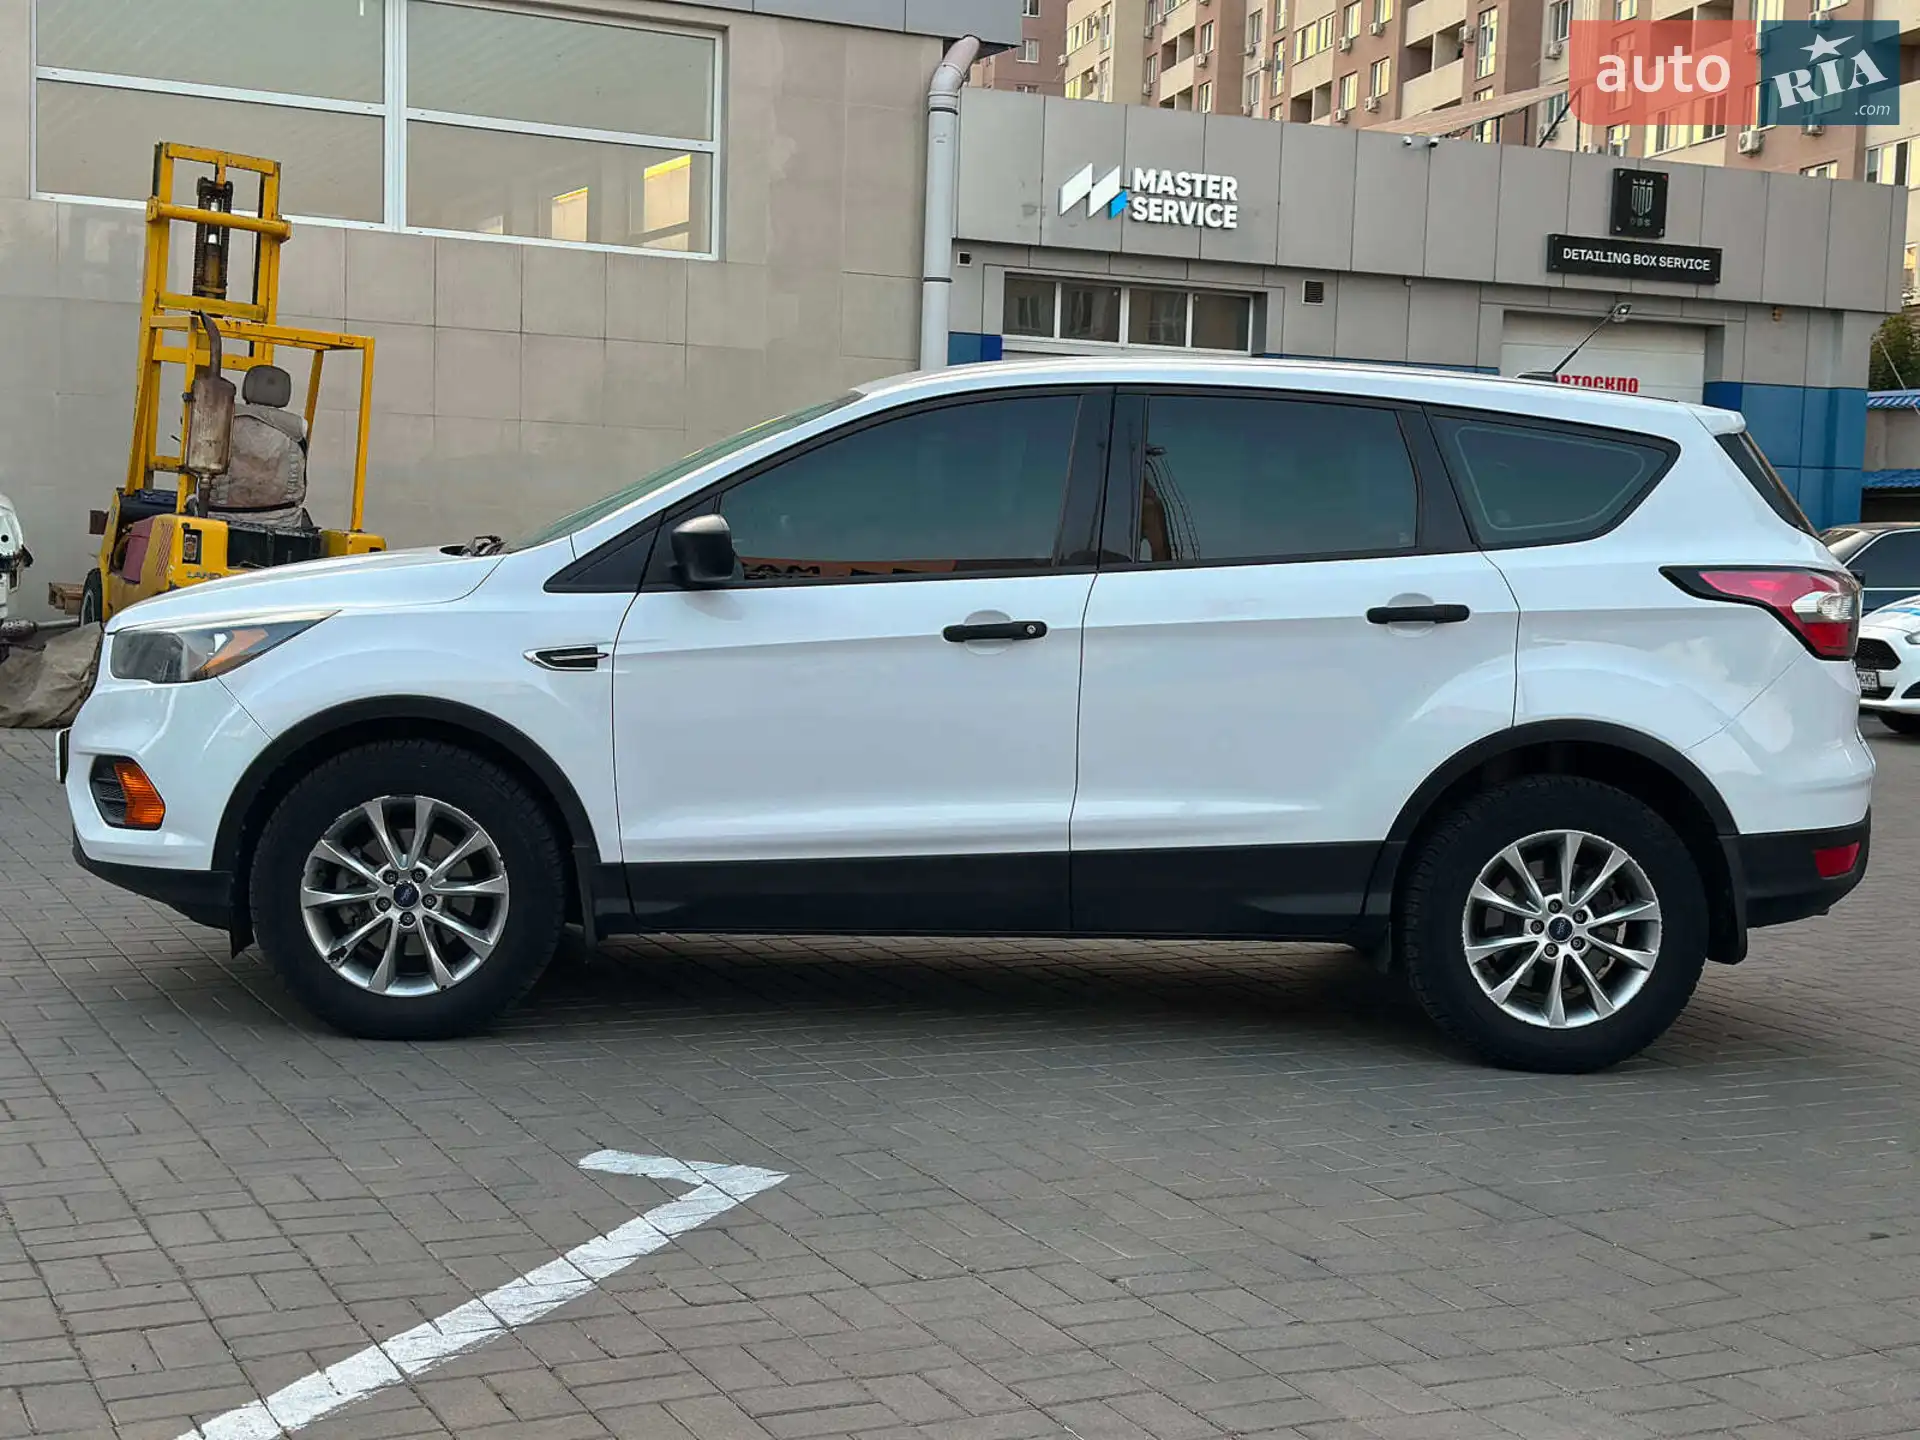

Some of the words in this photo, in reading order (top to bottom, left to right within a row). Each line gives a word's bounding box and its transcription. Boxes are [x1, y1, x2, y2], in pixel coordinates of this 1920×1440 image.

[1132, 167, 1238, 201] MASTER
[1132, 197, 1238, 229] SERVICE
[1563, 247, 1631, 265] DETAILING
[1633, 253, 1657, 267] BOX
[1659, 255, 1711, 271] SERVICE
[1556, 374, 1639, 394] ВТОСКЛО
